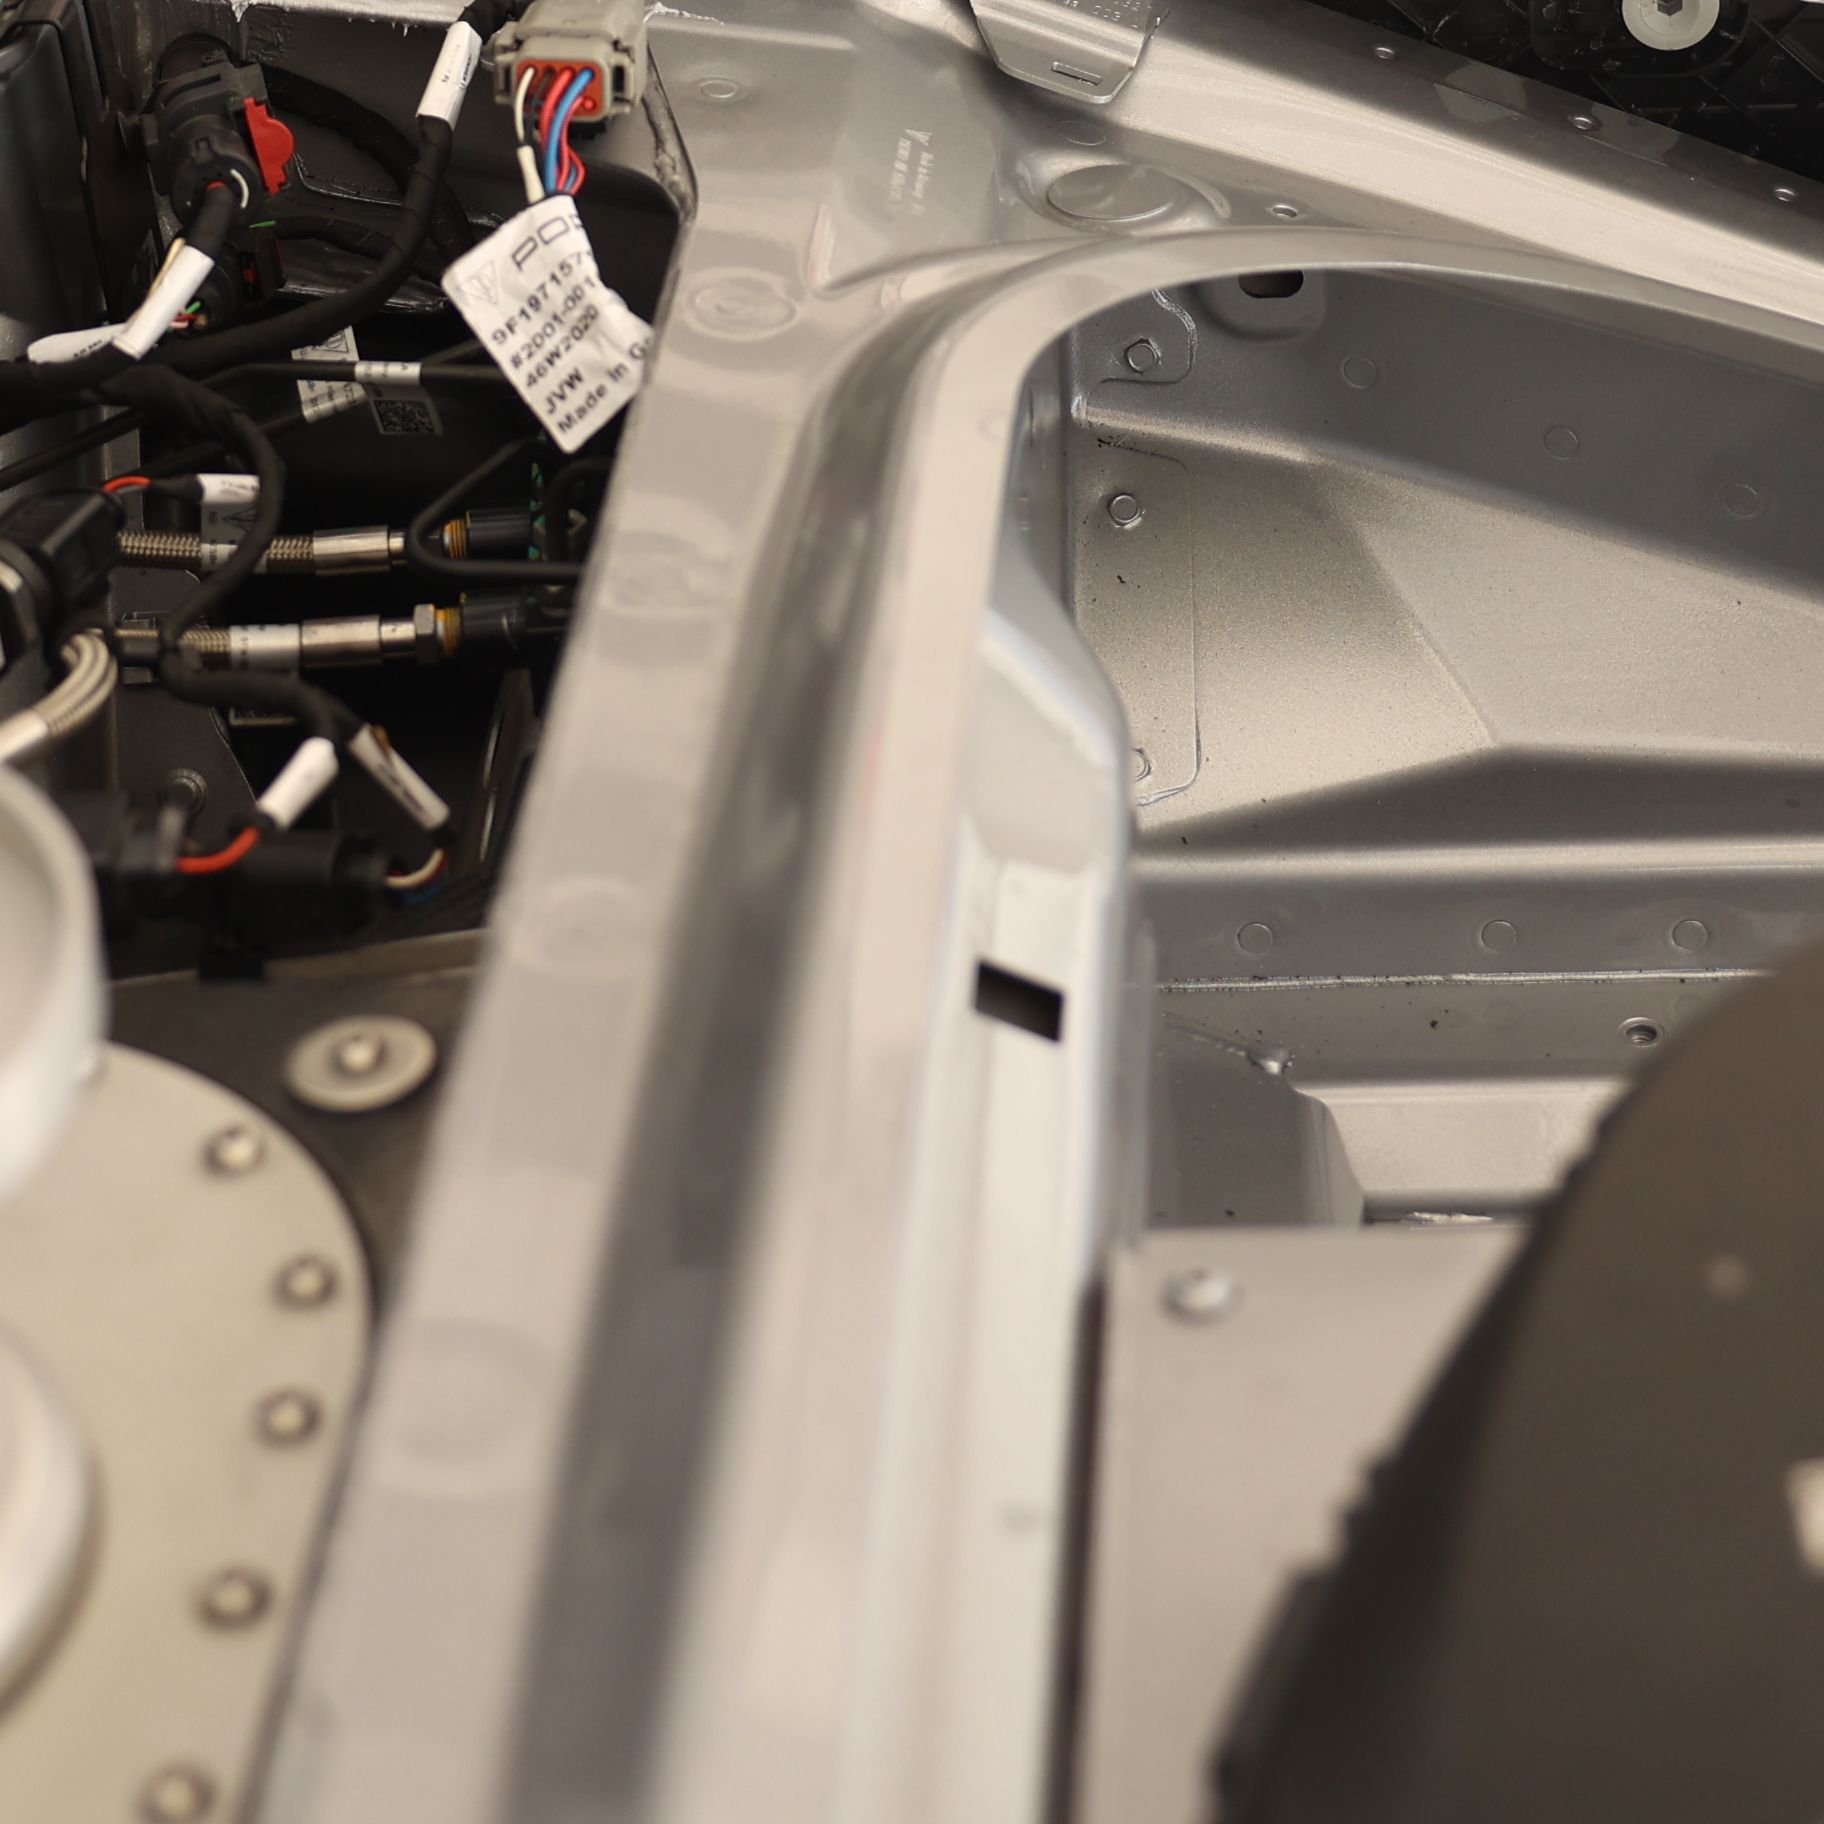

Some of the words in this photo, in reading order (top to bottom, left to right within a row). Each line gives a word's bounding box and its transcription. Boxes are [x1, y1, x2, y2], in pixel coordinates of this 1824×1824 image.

[526, 304, 599, 387] 46W2020
[545, 367, 584, 414] JVW
[557, 384, 608, 433] Made
